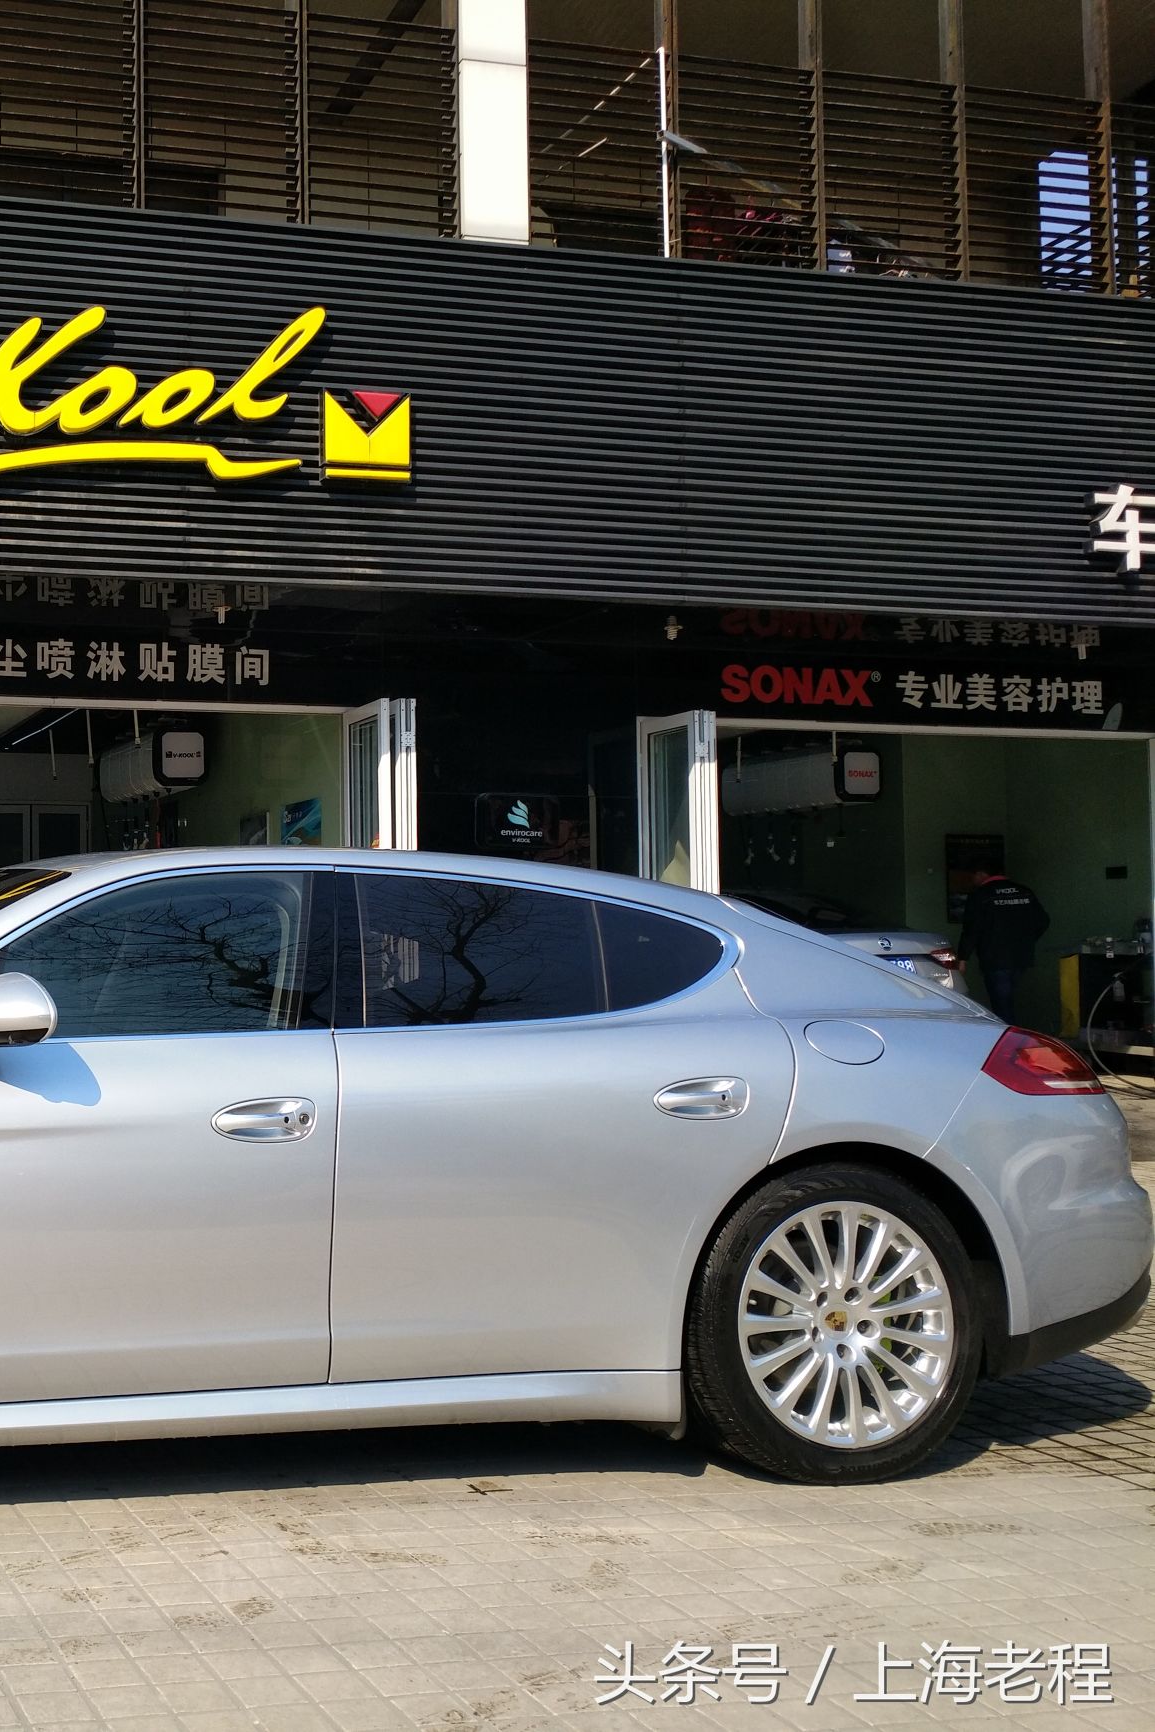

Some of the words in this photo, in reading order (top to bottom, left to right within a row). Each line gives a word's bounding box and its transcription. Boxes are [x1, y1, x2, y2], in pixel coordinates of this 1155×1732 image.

[1092, 483, 1155, 572] 车
[895, 670, 1106, 716] 专业美容护理
[500, 828, 543, 838] envirocare
